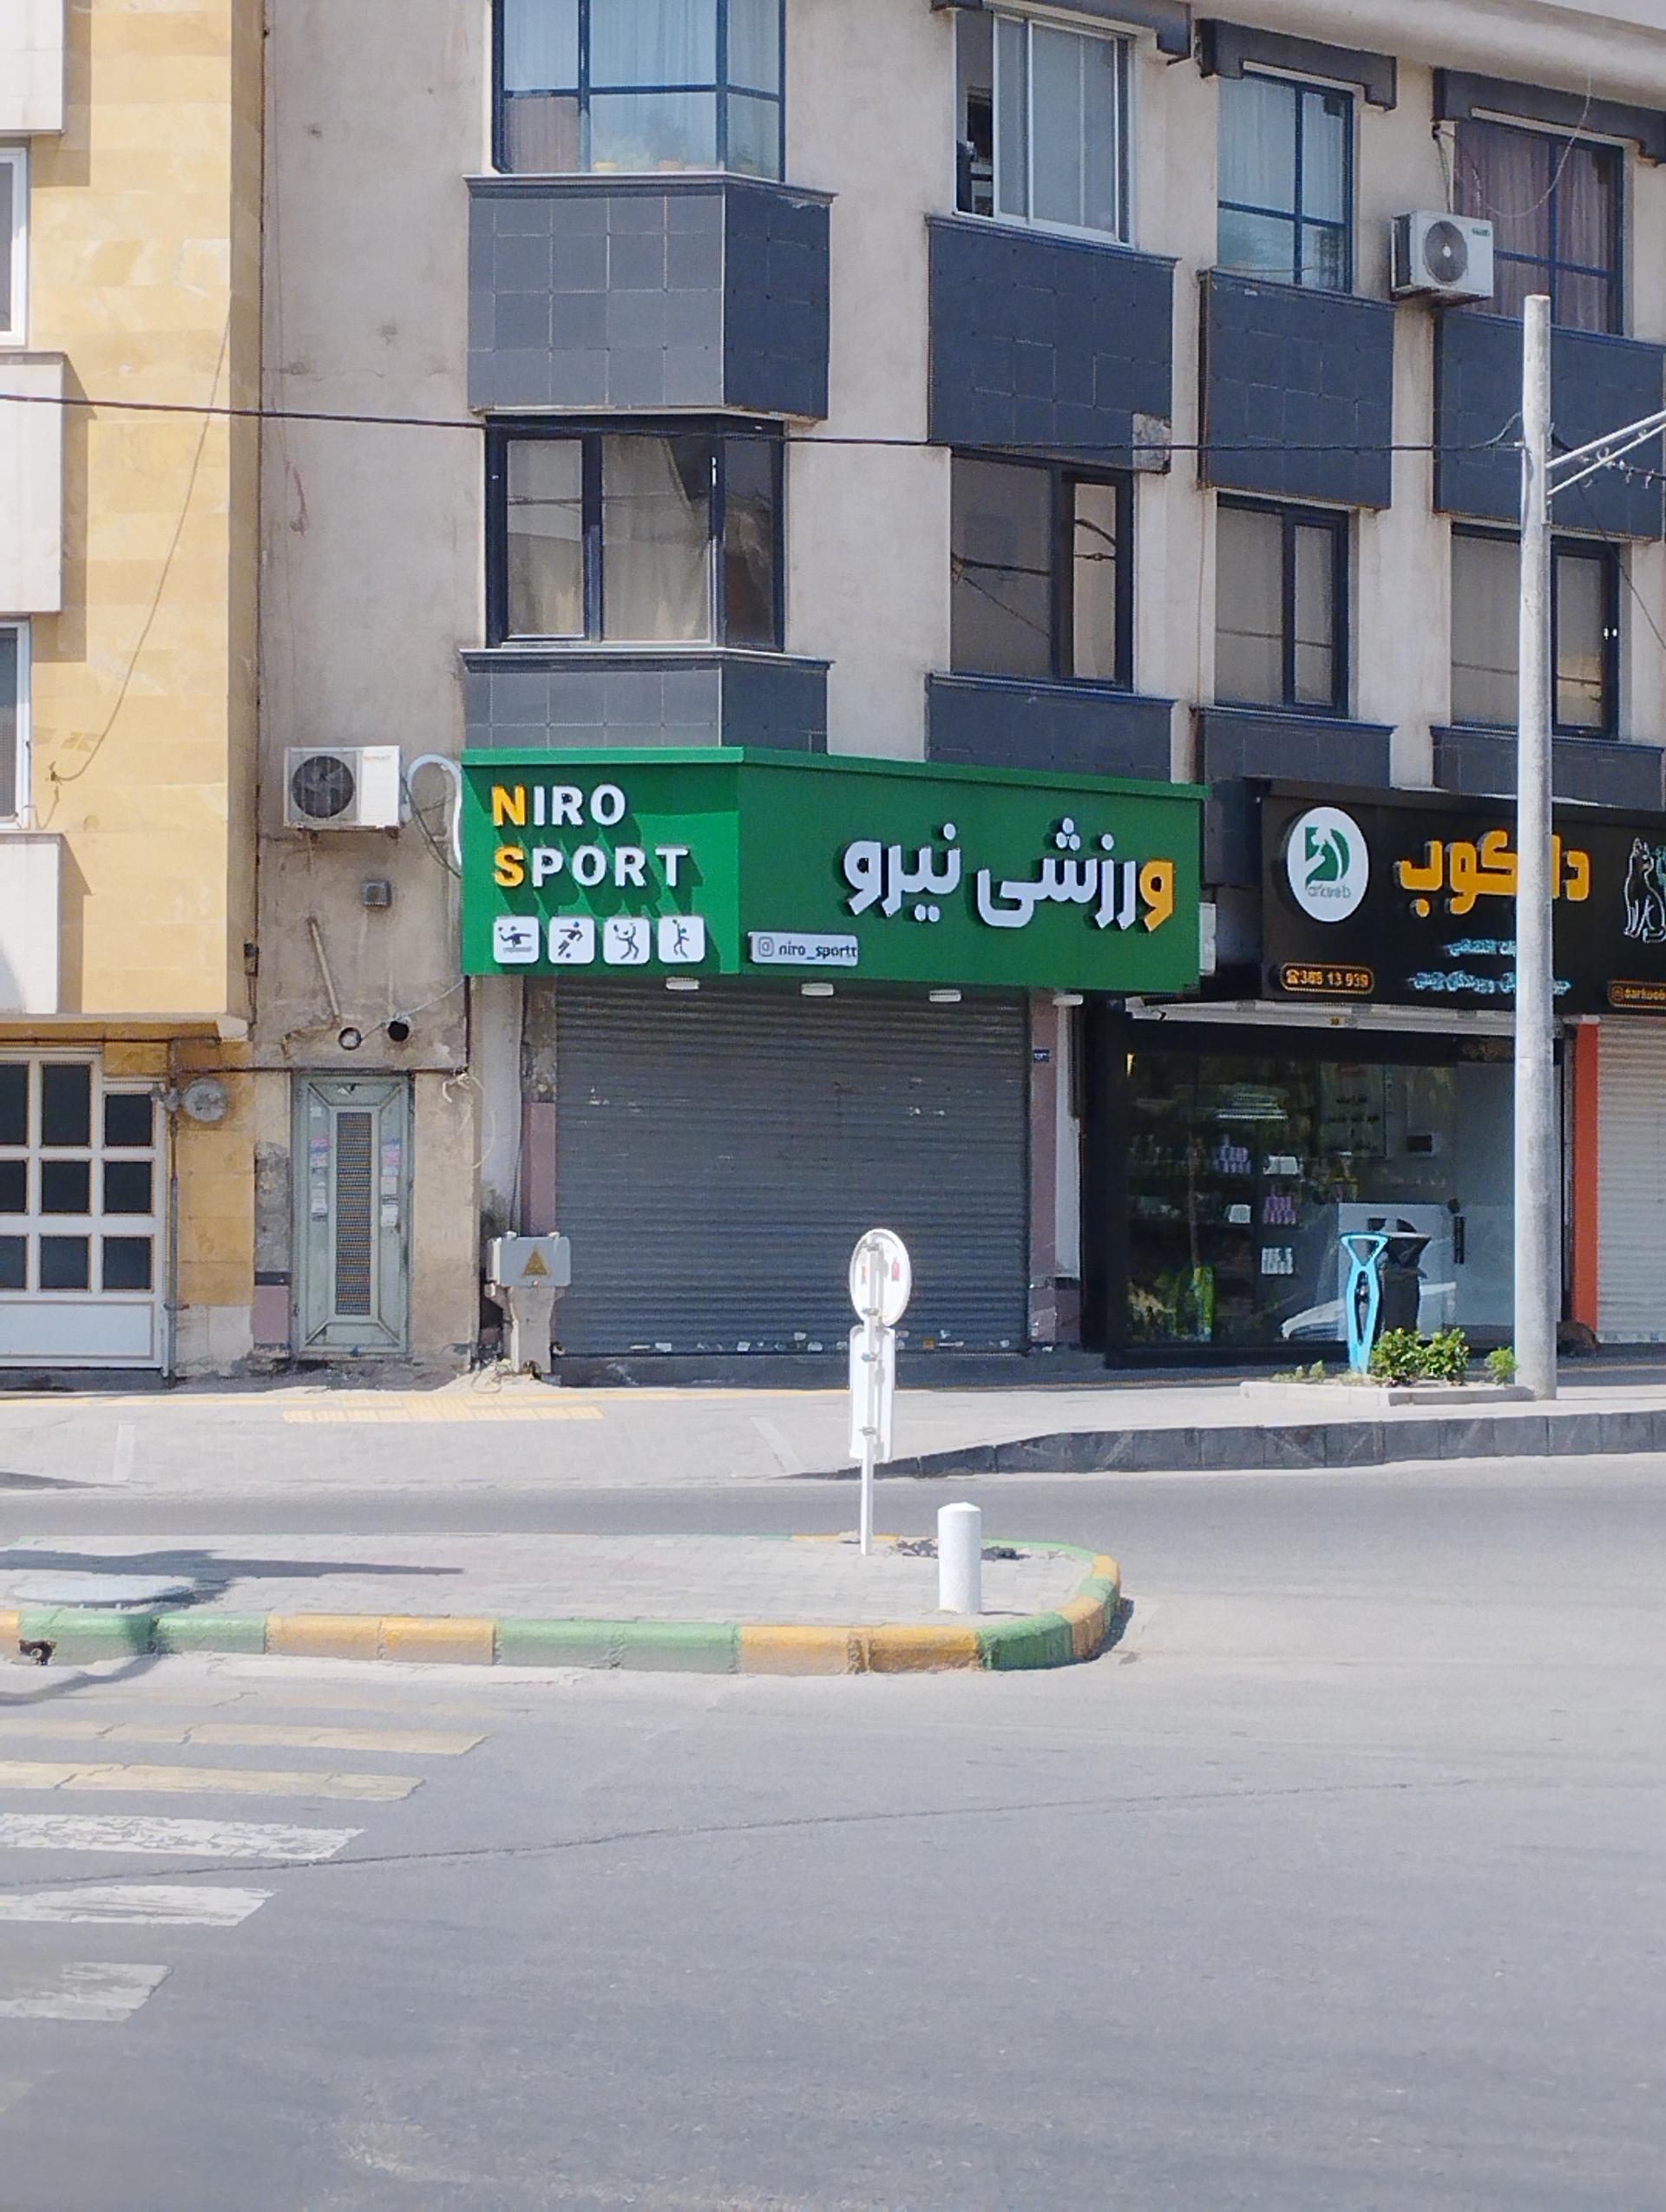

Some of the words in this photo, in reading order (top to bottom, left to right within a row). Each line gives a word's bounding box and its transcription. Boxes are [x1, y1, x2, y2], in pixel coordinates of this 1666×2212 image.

[491, 783, 626, 827] NIRO
[494, 845, 690, 887] SPORT
[843, 822, 961, 922] نیرو
[976, 817, 1174, 933] ورزشی
[1400, 830, 1590, 918] داکوب
[778, 939, 857, 960] niro_sportt
